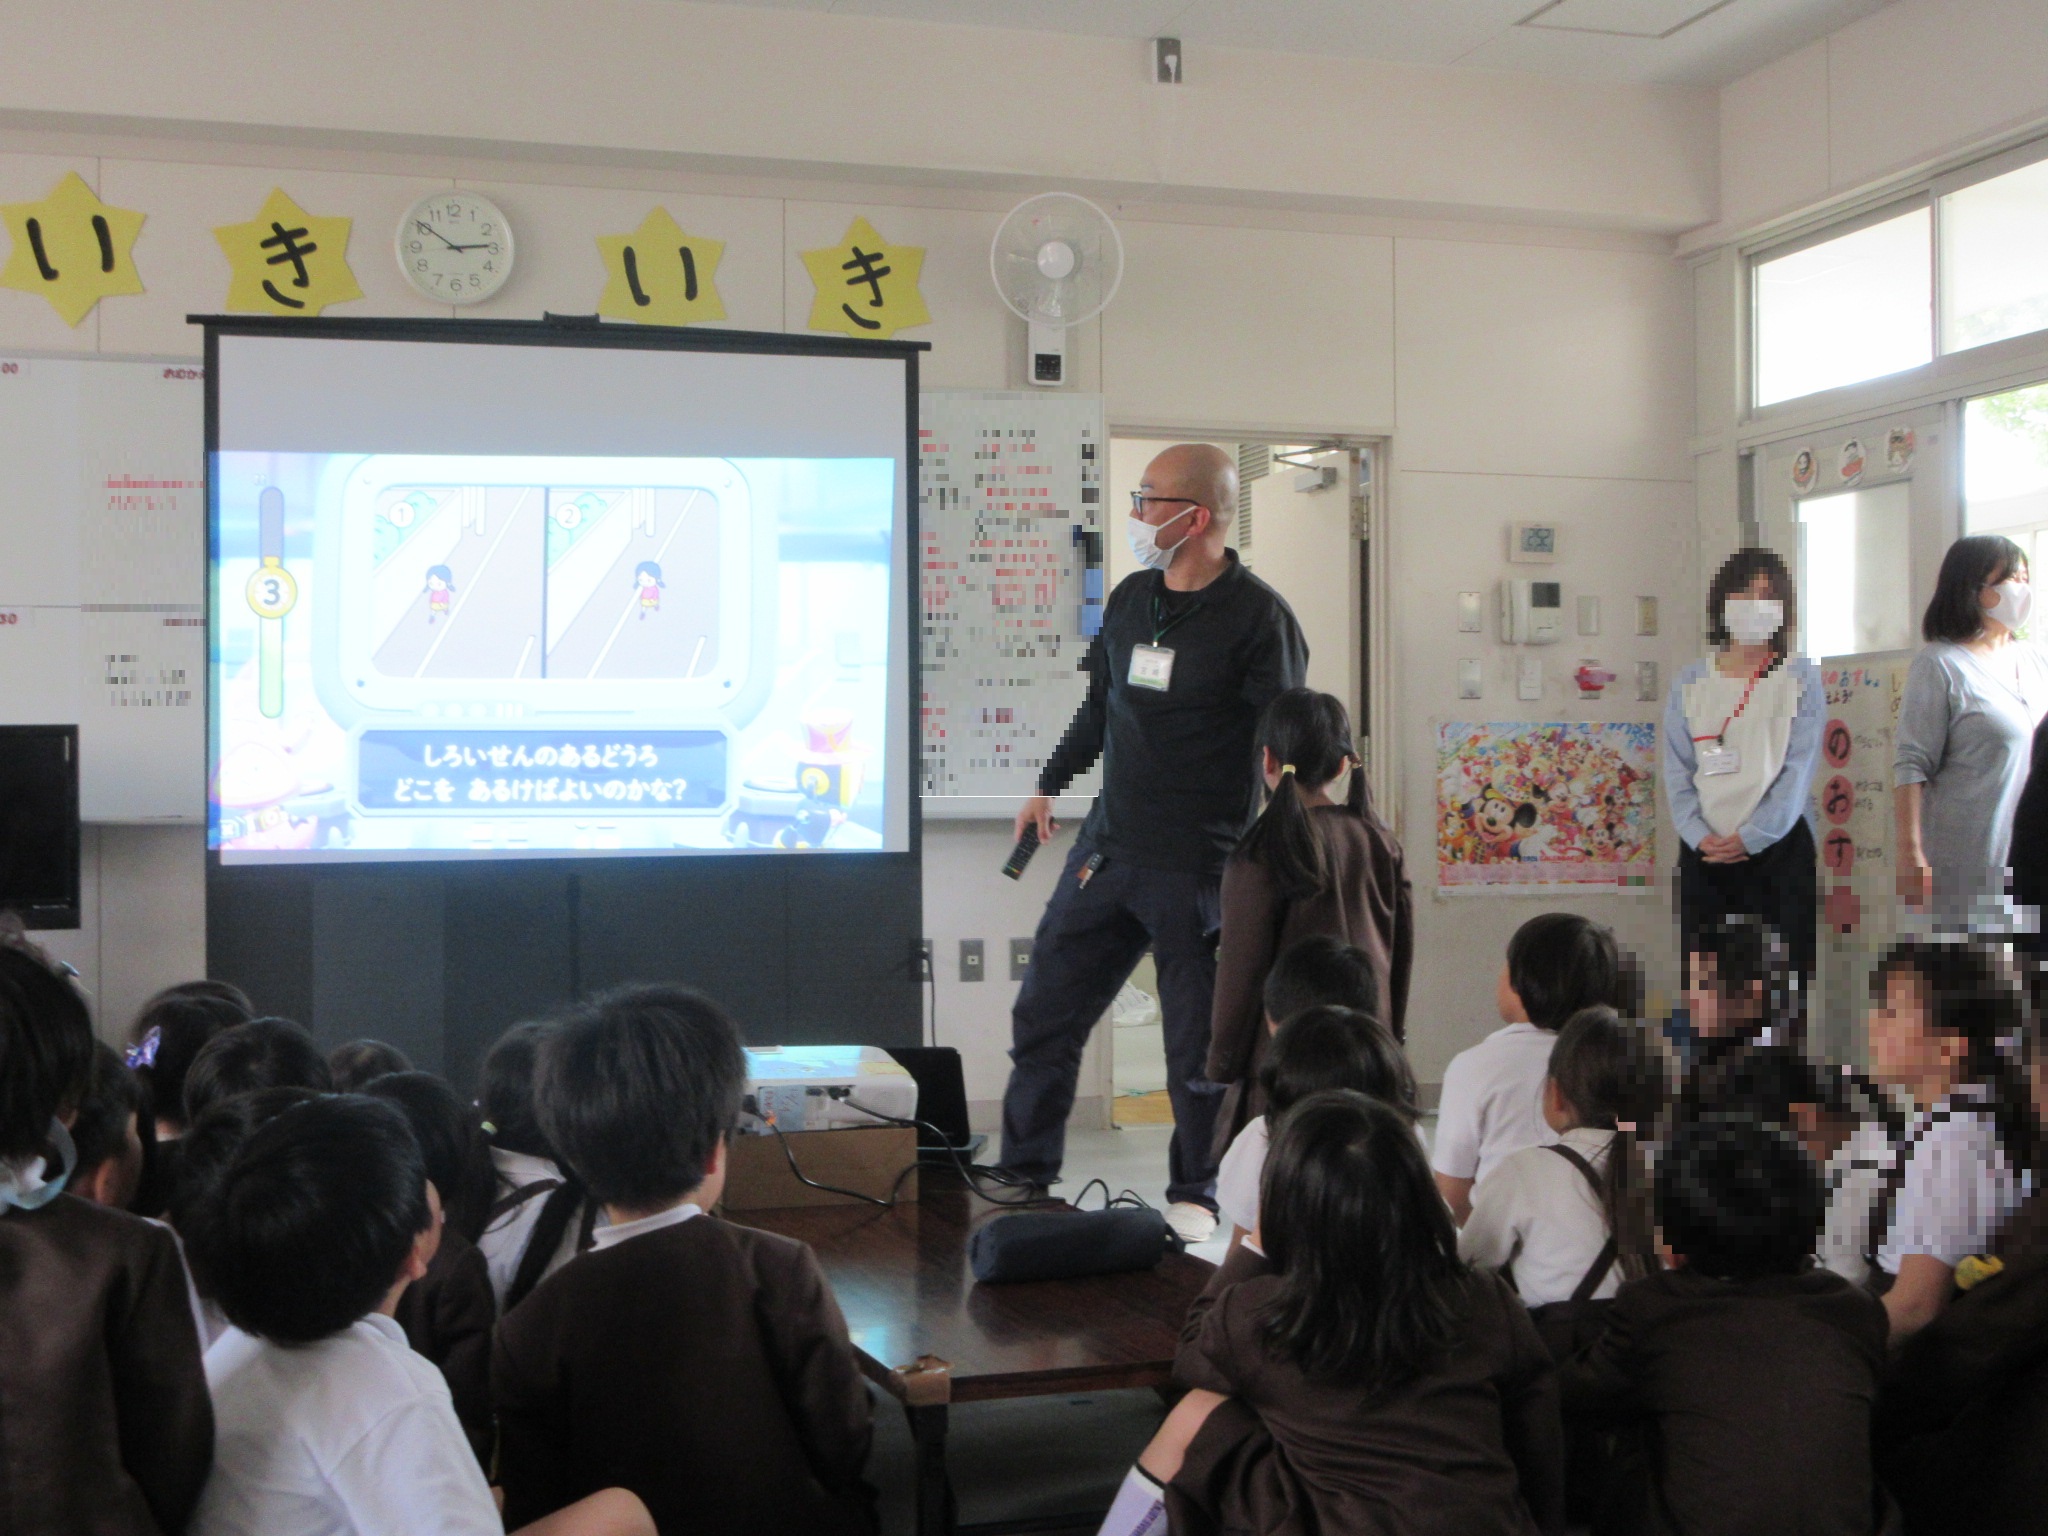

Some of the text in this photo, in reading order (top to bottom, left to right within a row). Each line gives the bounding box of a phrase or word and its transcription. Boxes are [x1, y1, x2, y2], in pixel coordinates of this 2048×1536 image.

[430, 210, 440, 222] 11
[446, 204, 461, 217] 12
[481, 223, 492, 236] 2
[410, 240, 422, 253] 9
[487, 242, 498, 255] 3
[417, 259, 428, 272] 8
[483, 260, 493, 273] 4
[26, 215, 891, 330] い き い き
[433, 273, 443, 286] 7
[450, 278, 462, 291] 6
[469, 274, 480, 287] 5
[564, 508, 574, 523] 2
[263, 579, 281, 605] 3
[423, 744, 658, 768] しろいせんのあるどうろ
[394, 777, 456, 801] どこを
